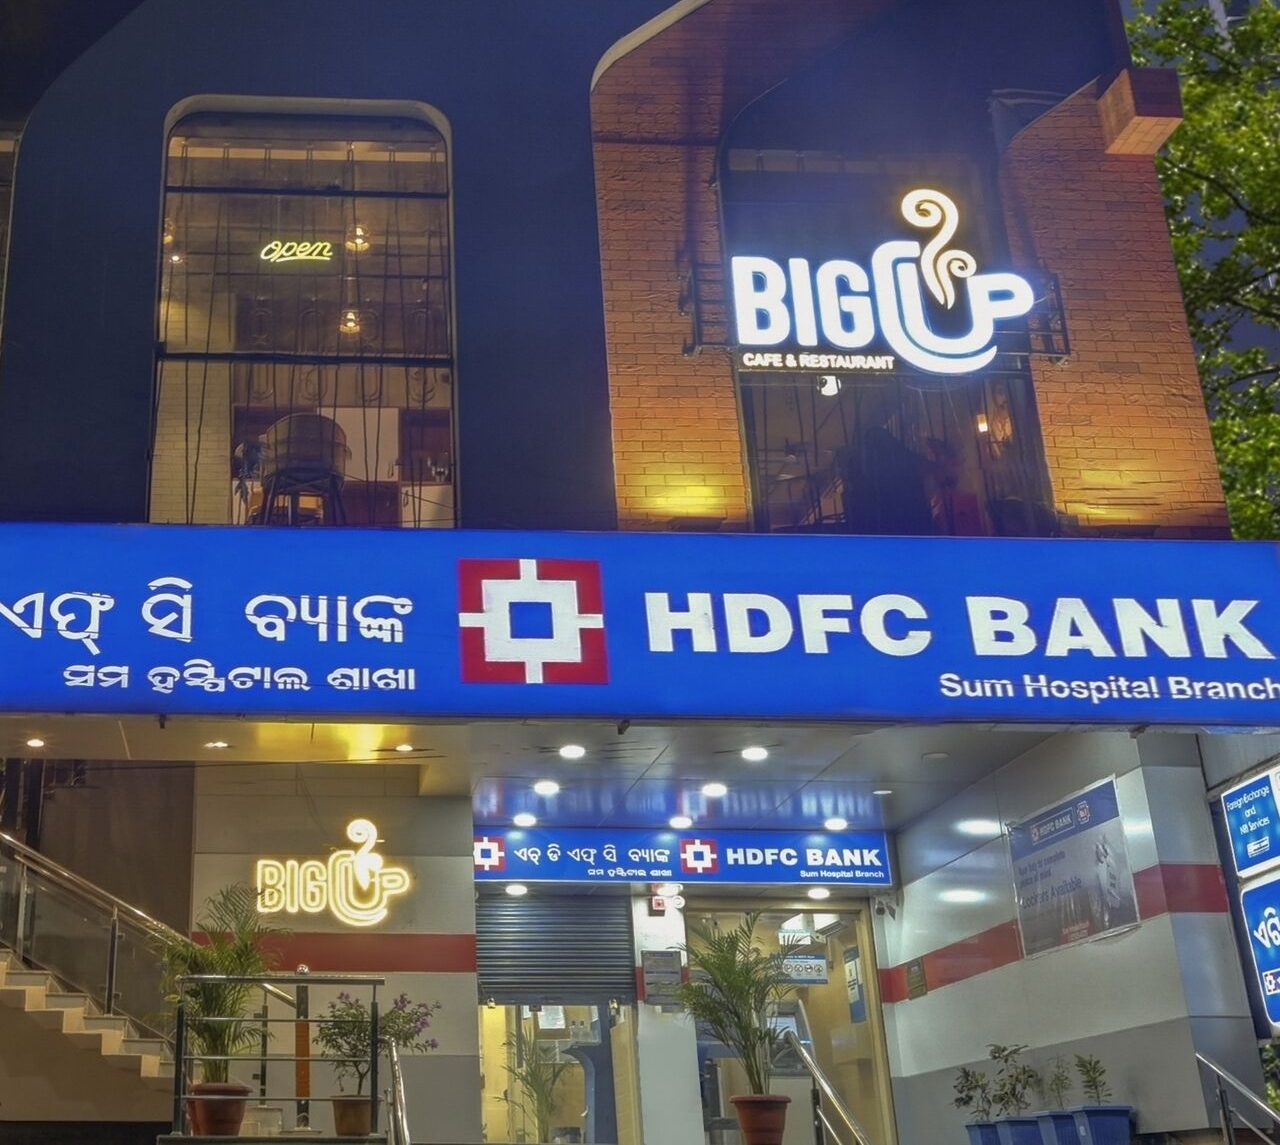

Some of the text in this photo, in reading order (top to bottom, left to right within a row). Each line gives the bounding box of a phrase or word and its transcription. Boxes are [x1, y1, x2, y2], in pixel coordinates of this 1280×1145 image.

[260, 240, 333, 262] open
[742, 352, 895, 370] CAFE & RESTAURANT
[644, 592, 1277, 660] HDFC BANK
[940, 673, 1014, 697] Sum
[1023, 675, 1160, 704] Hospital
[726, 848, 882, 866] HDFC BANK
[800, 870, 884, 879] Sum Hospital Branch
